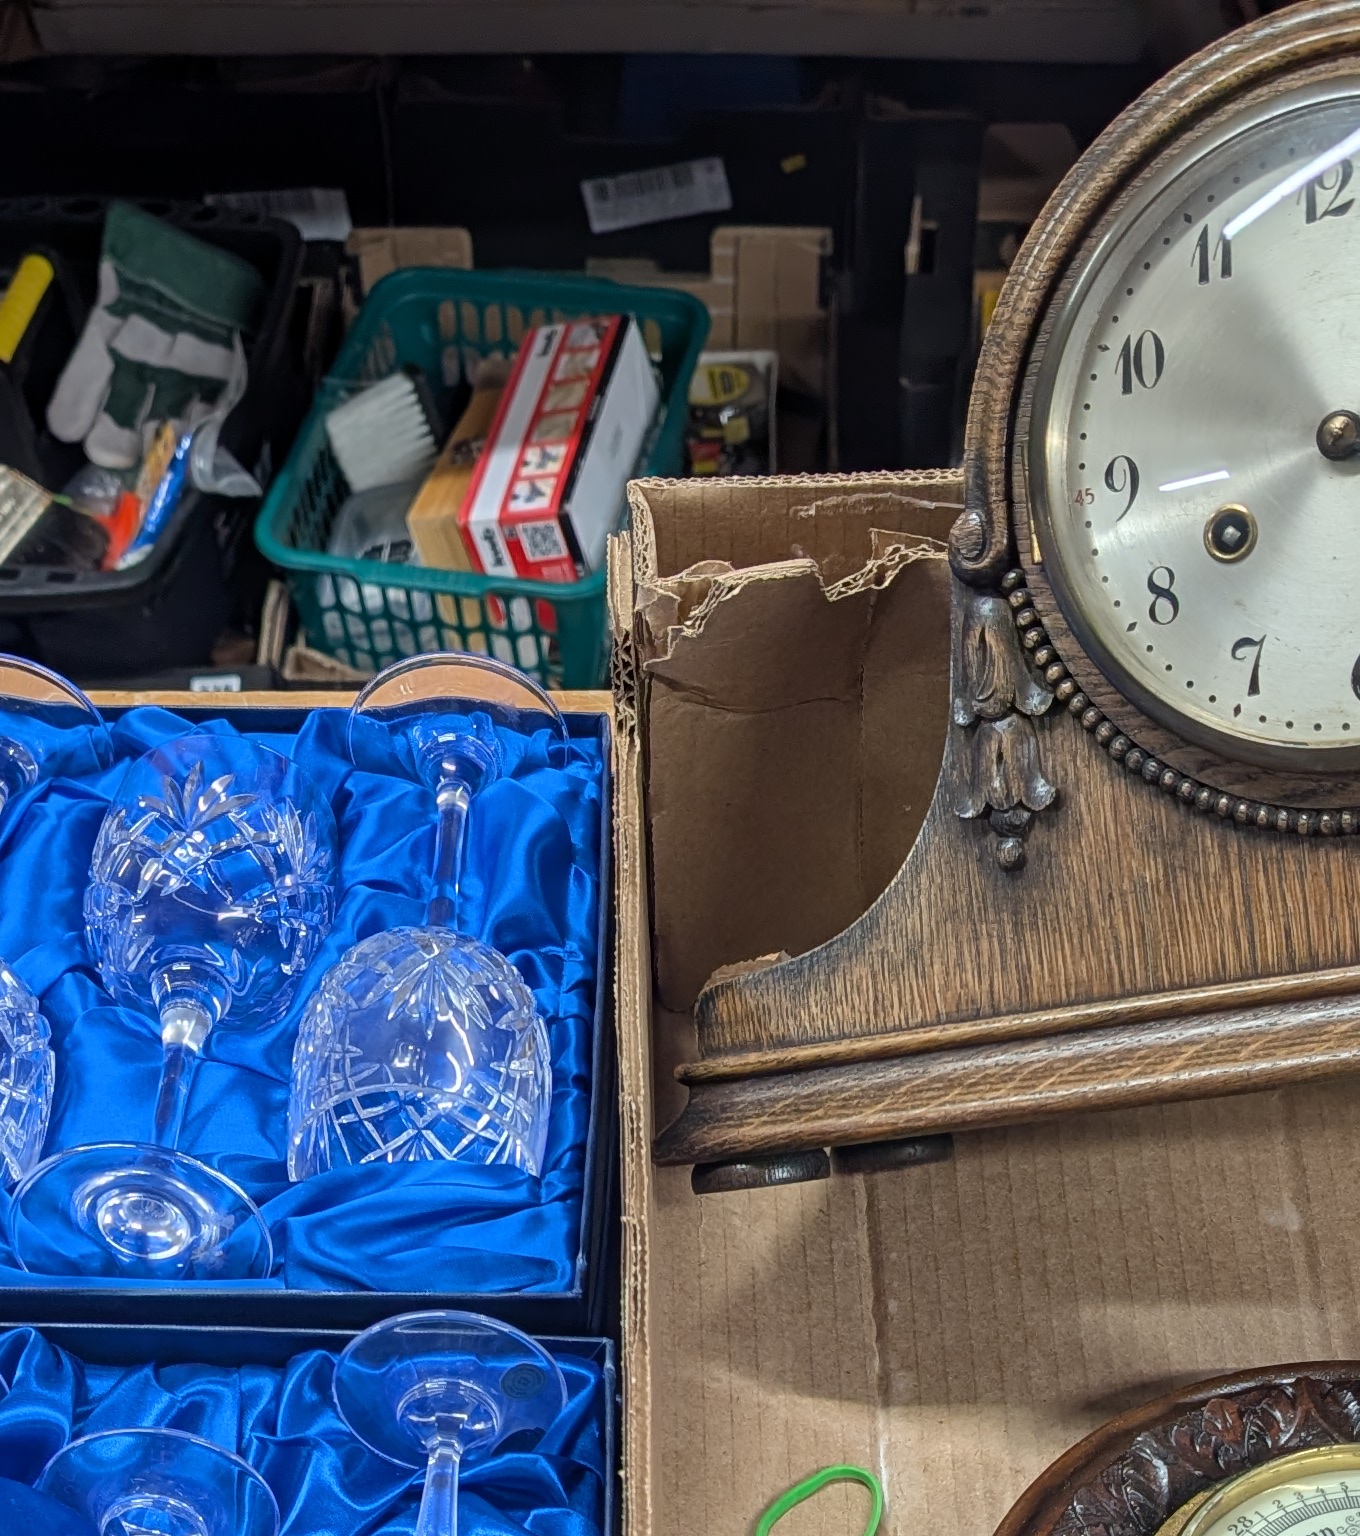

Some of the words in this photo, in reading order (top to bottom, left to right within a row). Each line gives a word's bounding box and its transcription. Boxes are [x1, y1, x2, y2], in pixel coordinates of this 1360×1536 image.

[1297, 158, 1355, 224] 12
[1190, 222, 1234, 286] 11
[1114, 328, 1166, 396] 10
[1103, 454, 1140, 523] 9
[1146, 565, 1180, 626] 8
[1230, 633, 1267, 697] 7
[1227, 1515, 1254, 1536] 28
